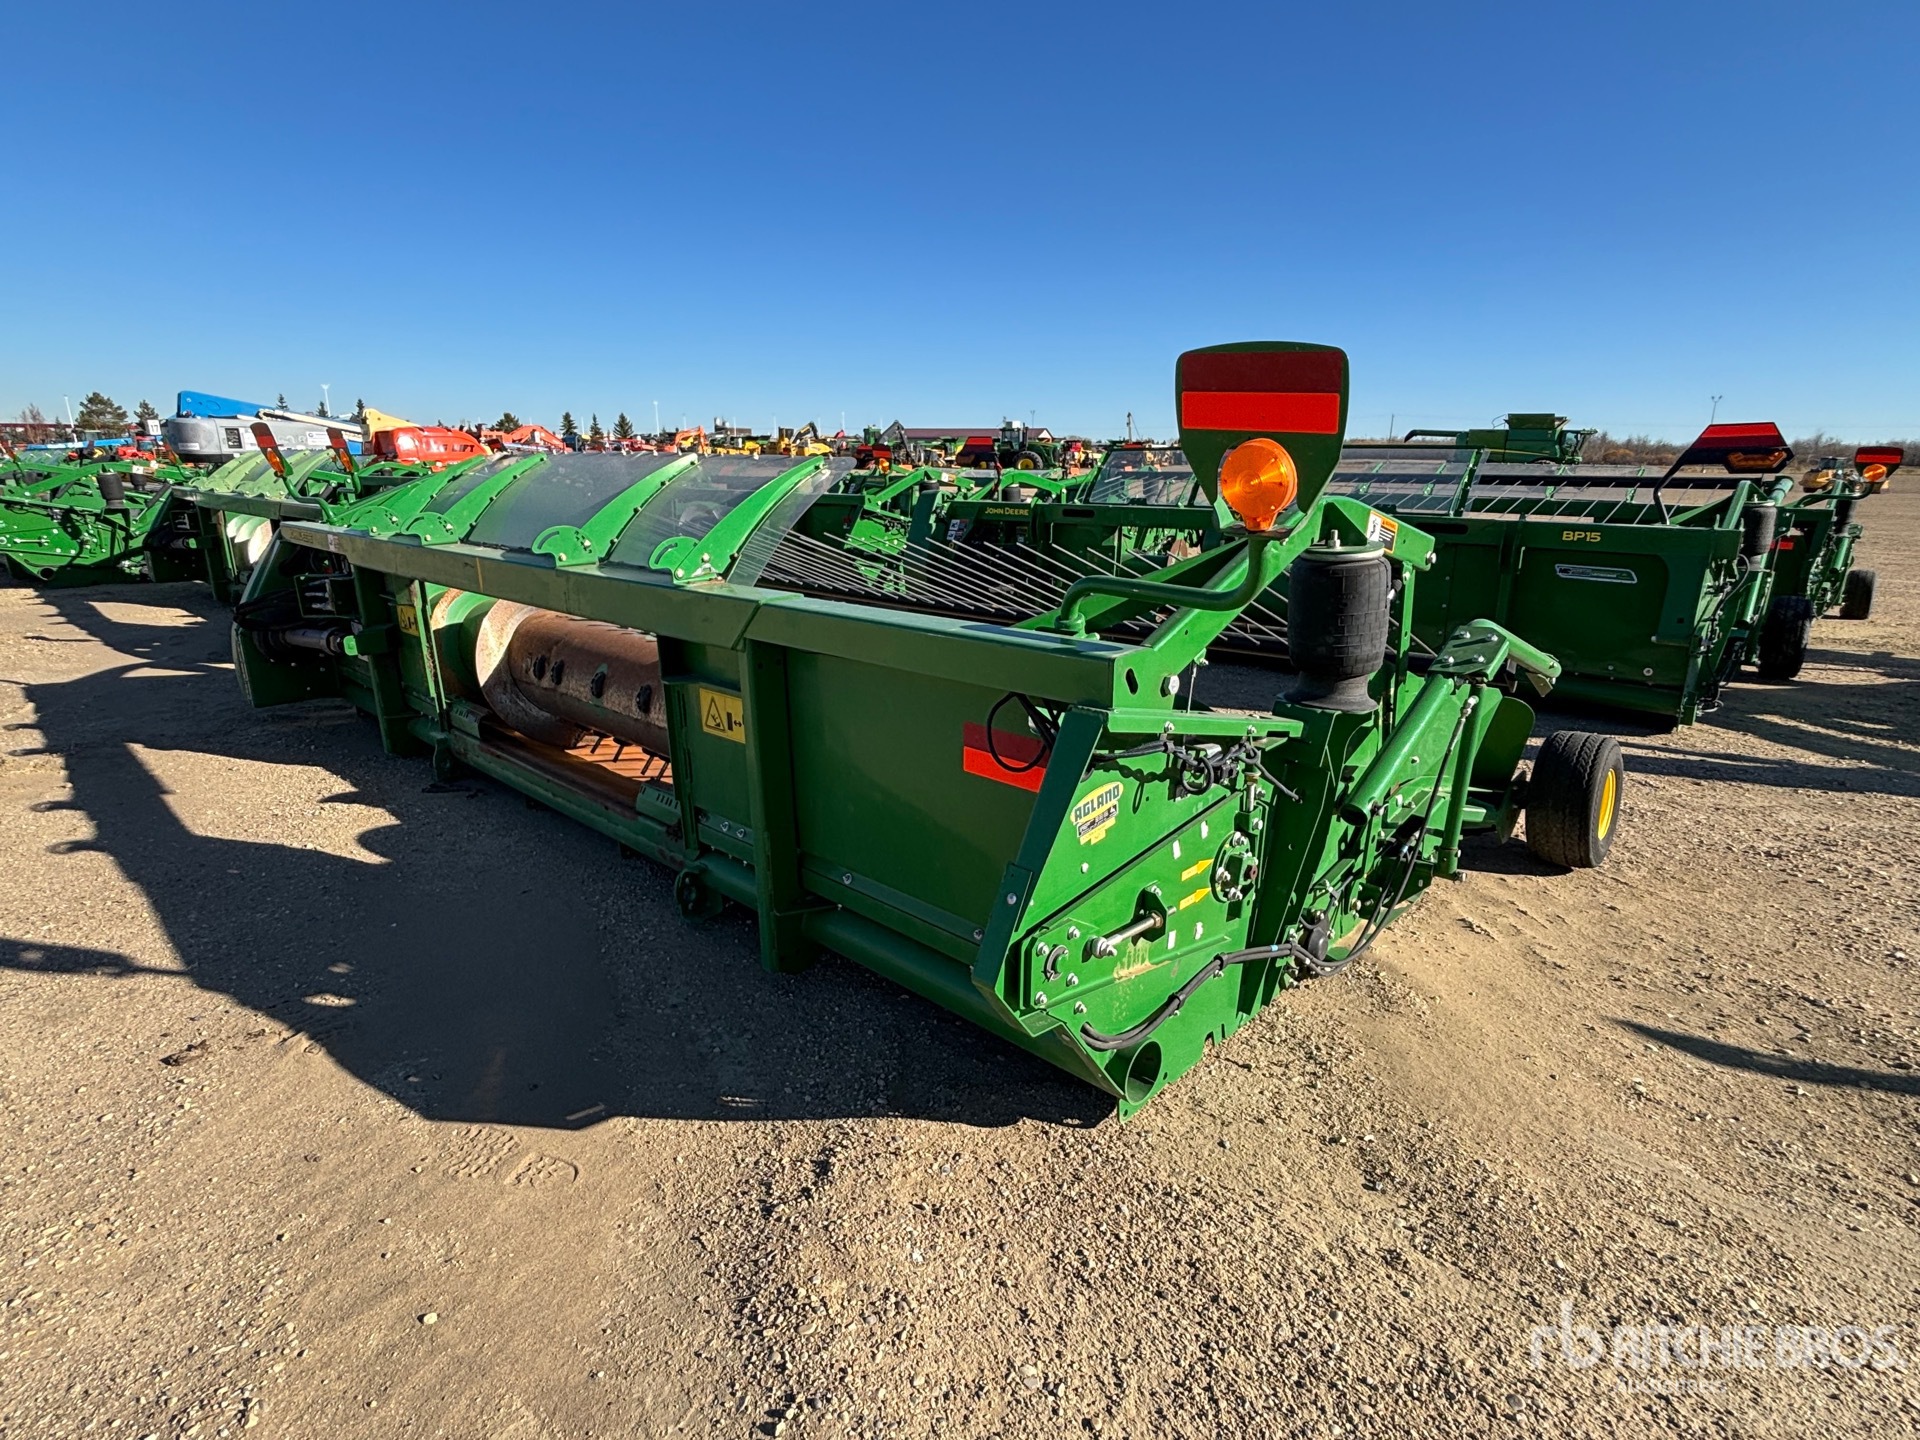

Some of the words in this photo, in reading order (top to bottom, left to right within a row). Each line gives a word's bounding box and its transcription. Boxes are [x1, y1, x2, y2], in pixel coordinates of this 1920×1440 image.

[985, 507, 1003, 515] JOHN
[1005, 507, 1029, 516] DEERE
[1562, 530, 1602, 543] BP15
[1074, 784, 1120, 822] AGLAND
